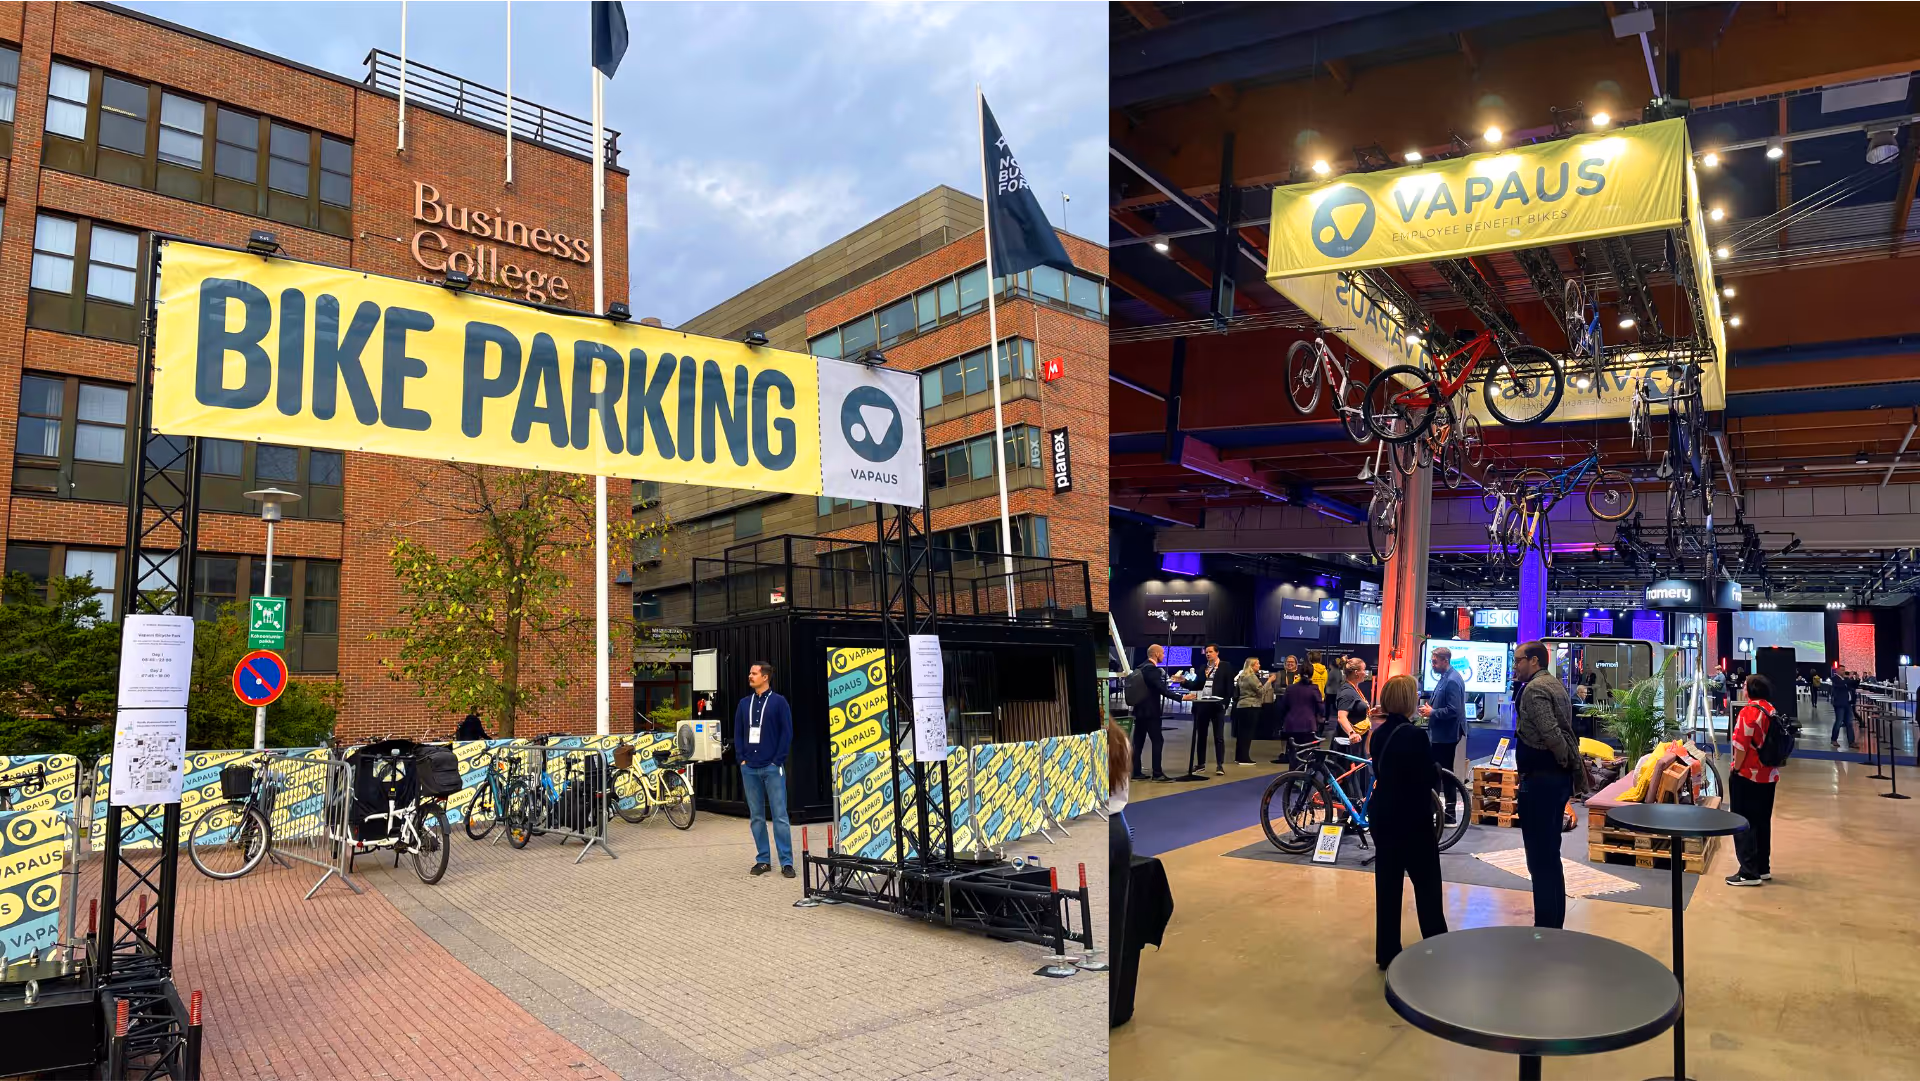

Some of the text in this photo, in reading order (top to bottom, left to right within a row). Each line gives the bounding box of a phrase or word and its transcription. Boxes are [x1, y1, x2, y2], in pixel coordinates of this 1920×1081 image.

[999, 168, 1025, 182] BU
[1394, 158, 1605, 222] VAPAUS
[413, 180, 591, 263] Business
[1392, 209, 1568, 242] EMPLOYEE BENEFIT BIKES
[411, 229, 569, 304] College
[195, 277, 797, 471] BIKE PARKING
[1054, 431, 1070, 488] planex
[850, 468, 898, 485] VAPAUS
[1646, 587, 1691, 602] framery
[862, 693, 887, 710] VAPA
[841, 726, 876, 748] VAPAUS
[458, 744, 482, 756] VAPAUS
[9, 766, 39, 780] APAUS
[852, 756, 874, 775] VAPAUS
[45, 772, 75, 786] APAUS
[186, 771, 219, 785] VAPAUS
[448, 792, 472, 804] VAPAUS
[860, 796, 881, 815] VAPAUS
[880, 807, 895, 823] VAPA
[847, 829, 869, 850] VAPAUS
[868, 836, 888, 856] VAPAUS
[10, 924, 58, 947] VAPA
